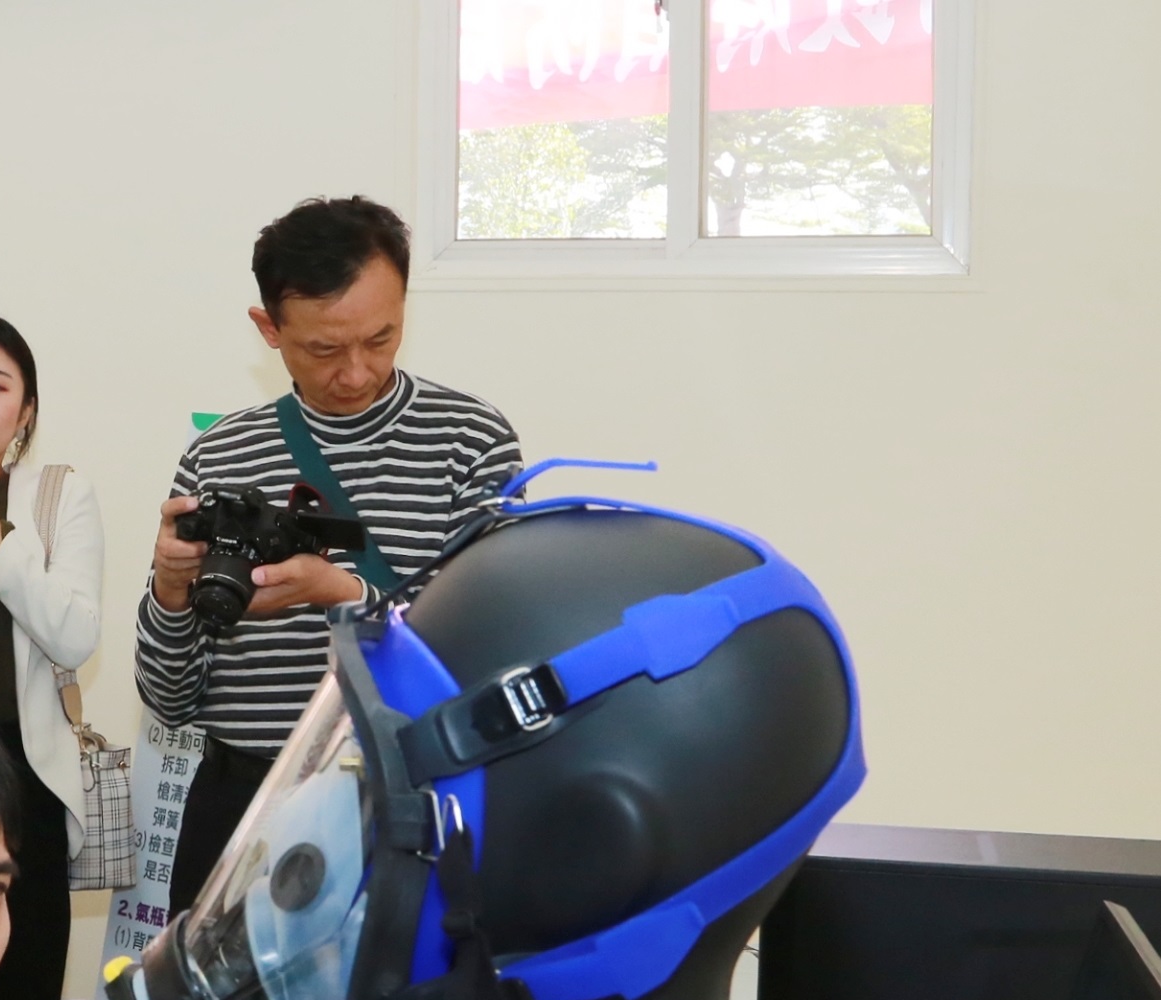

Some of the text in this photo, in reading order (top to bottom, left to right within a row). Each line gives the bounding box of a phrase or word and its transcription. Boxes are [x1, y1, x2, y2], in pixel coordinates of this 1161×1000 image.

[152, 806, 180, 831] 彈簧
[134, 828, 175, 857] 3)檢查
[143, 859, 171, 884] 是否
[117, 899, 170, 928] 2、氣瓶
